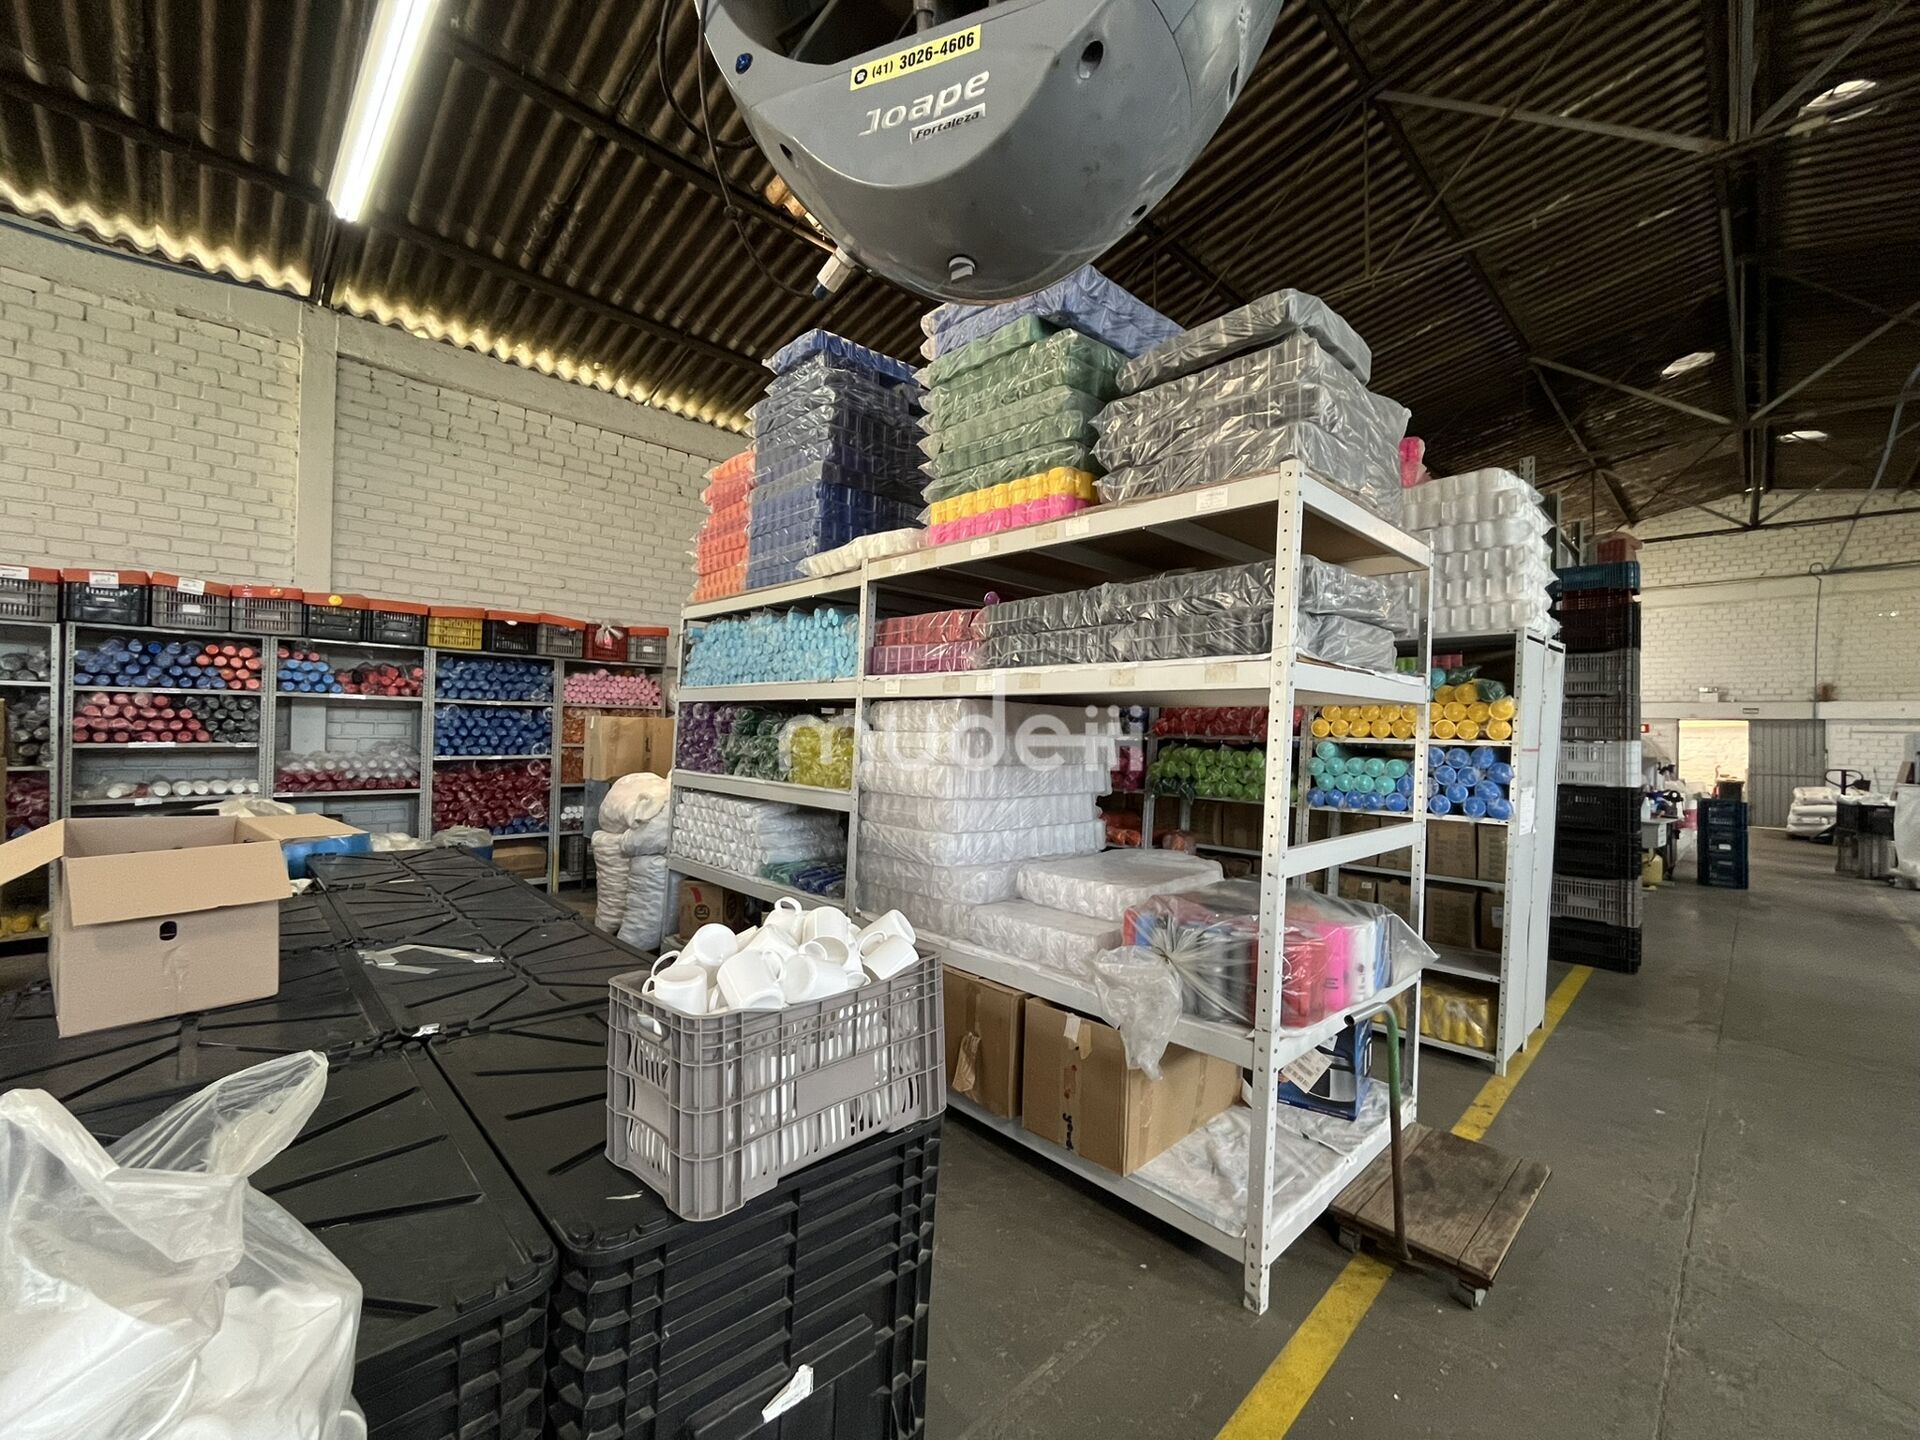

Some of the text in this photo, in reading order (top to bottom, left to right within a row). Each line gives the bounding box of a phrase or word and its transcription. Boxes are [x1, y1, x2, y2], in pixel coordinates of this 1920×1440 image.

[872, 32, 975, 78] (41) 3026-4606
[858, 70, 990, 136] Joape
[915, 110, 980, 139] Fortaleza
